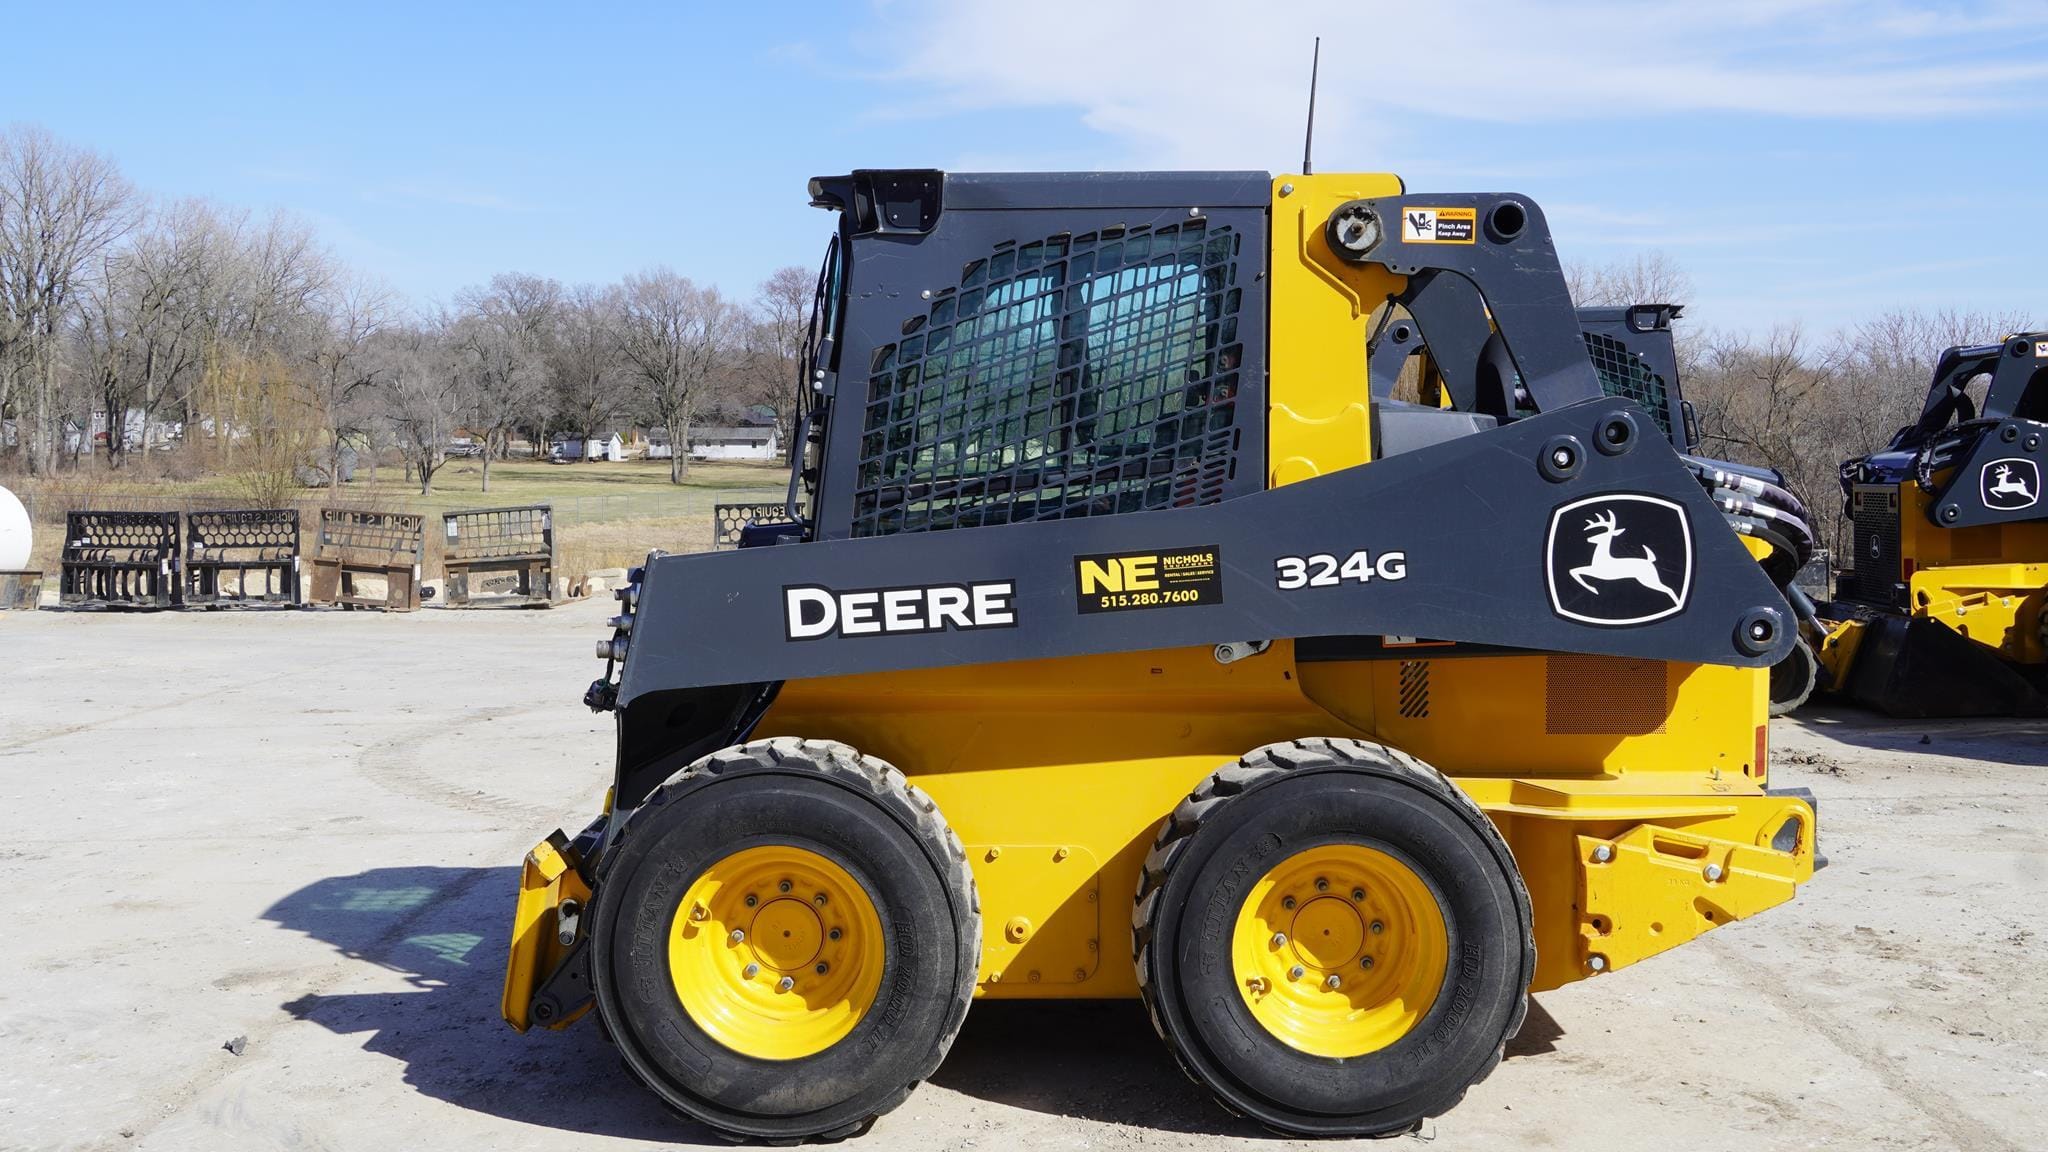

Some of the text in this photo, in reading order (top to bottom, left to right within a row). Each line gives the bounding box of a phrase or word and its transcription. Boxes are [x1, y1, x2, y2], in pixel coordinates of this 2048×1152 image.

[1080, 556, 1159, 594] NE
[1163, 553, 1213, 565] NICHOLS
[1276, 551, 1407, 589] 324G
[786, 583, 1014, 638] DEERE
[1101, 589, 1199, 608] 515.280.7600
